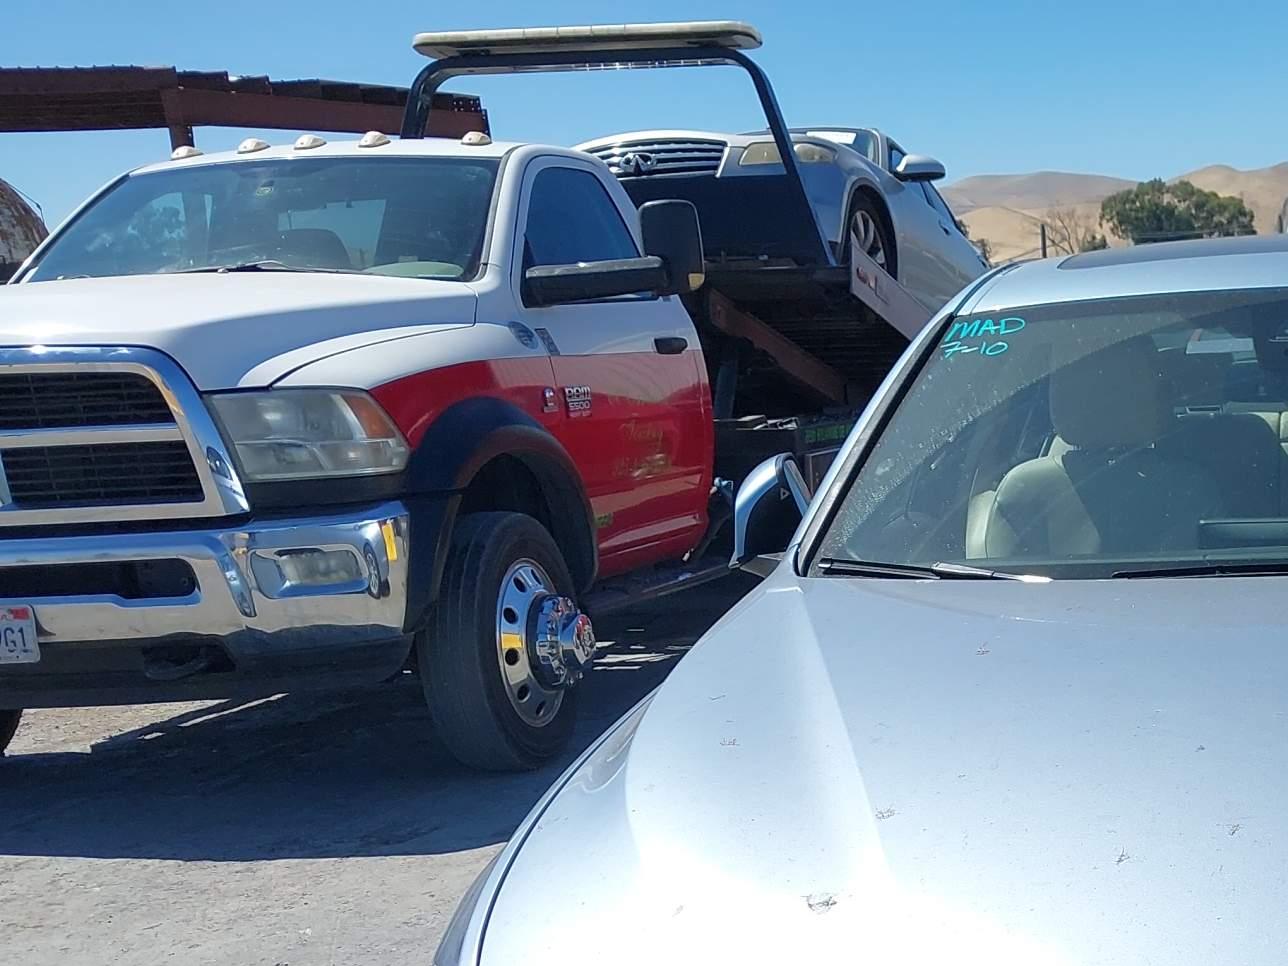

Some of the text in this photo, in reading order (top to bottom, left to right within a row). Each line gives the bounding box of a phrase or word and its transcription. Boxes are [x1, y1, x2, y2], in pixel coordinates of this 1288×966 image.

[944, 317, 1026, 343] MAD
[940, 341, 1009, 358] 7-10
[568, 400, 591, 411] 5500
[0, 626, 32, 653] G1
